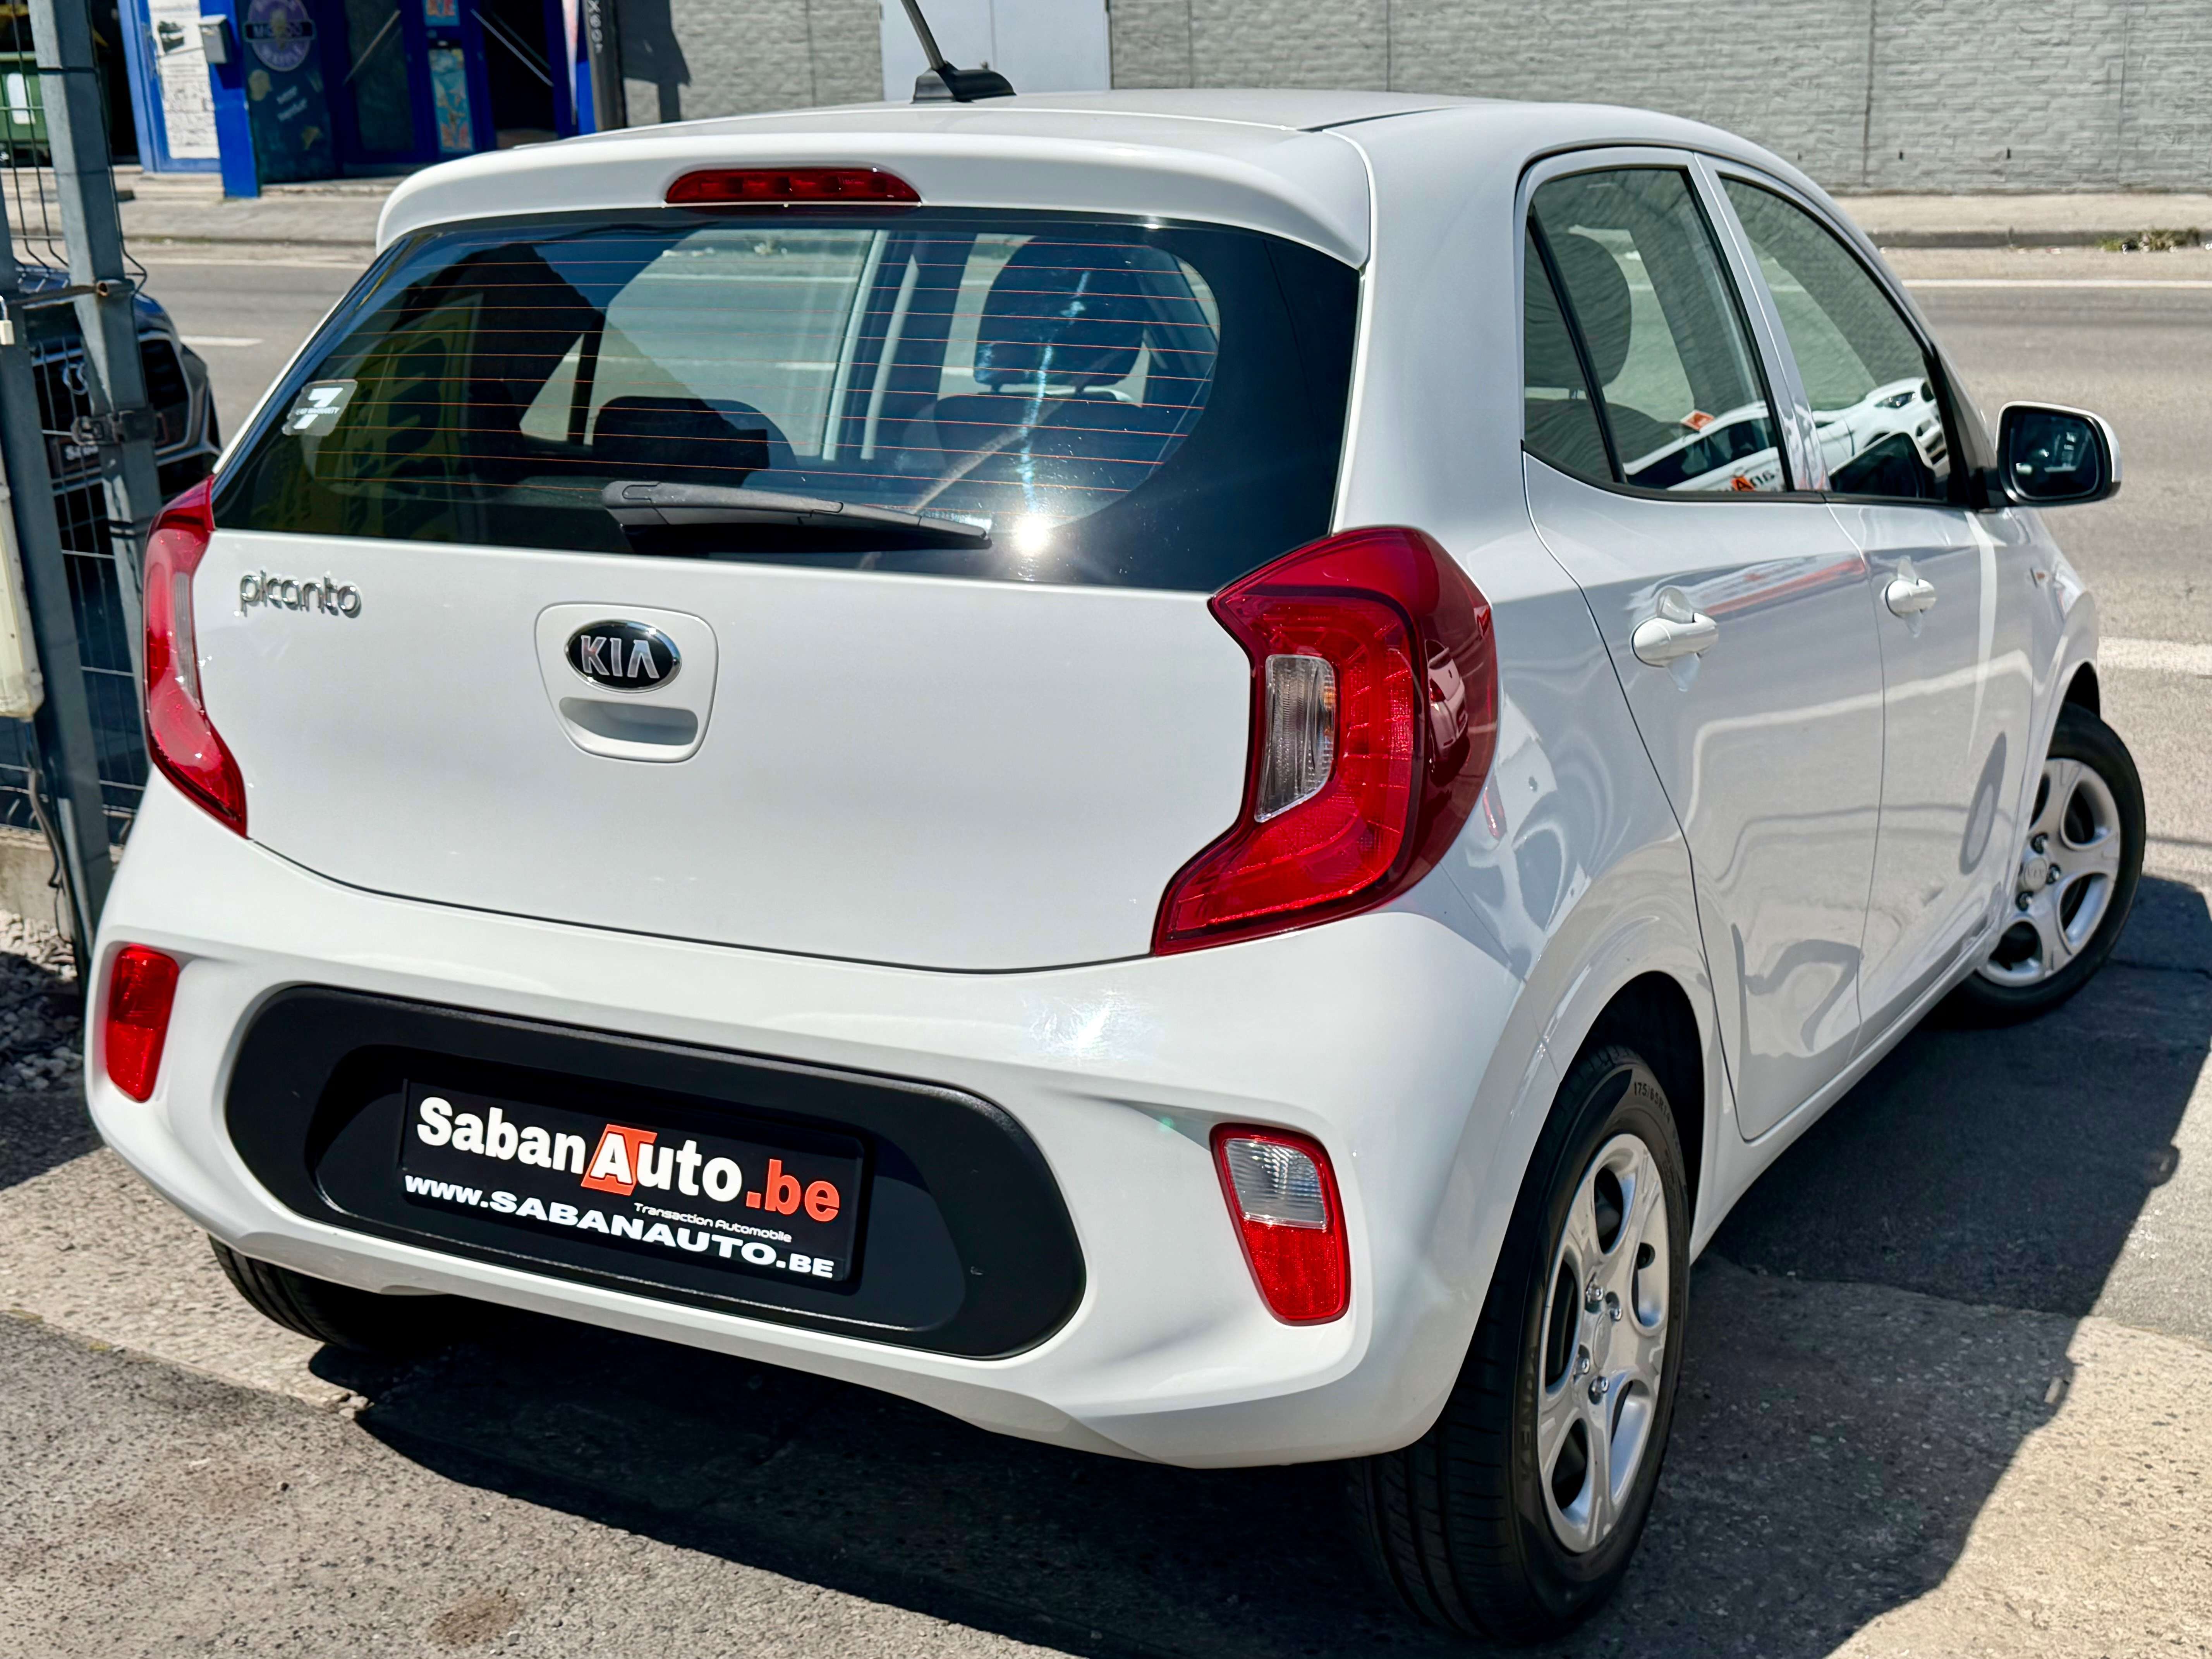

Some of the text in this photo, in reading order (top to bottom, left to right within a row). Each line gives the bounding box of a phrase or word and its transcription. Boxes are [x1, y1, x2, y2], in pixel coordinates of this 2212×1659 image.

[240, 570, 362, 618] picanto
[580, 635, 660, 679] KIA
[416, 1096, 840, 1223] SabanAuto.be
[404, 1174, 835, 1279] www.SABANAUTO.BE
[634, 1202, 793, 1243] Transaction Automobile
